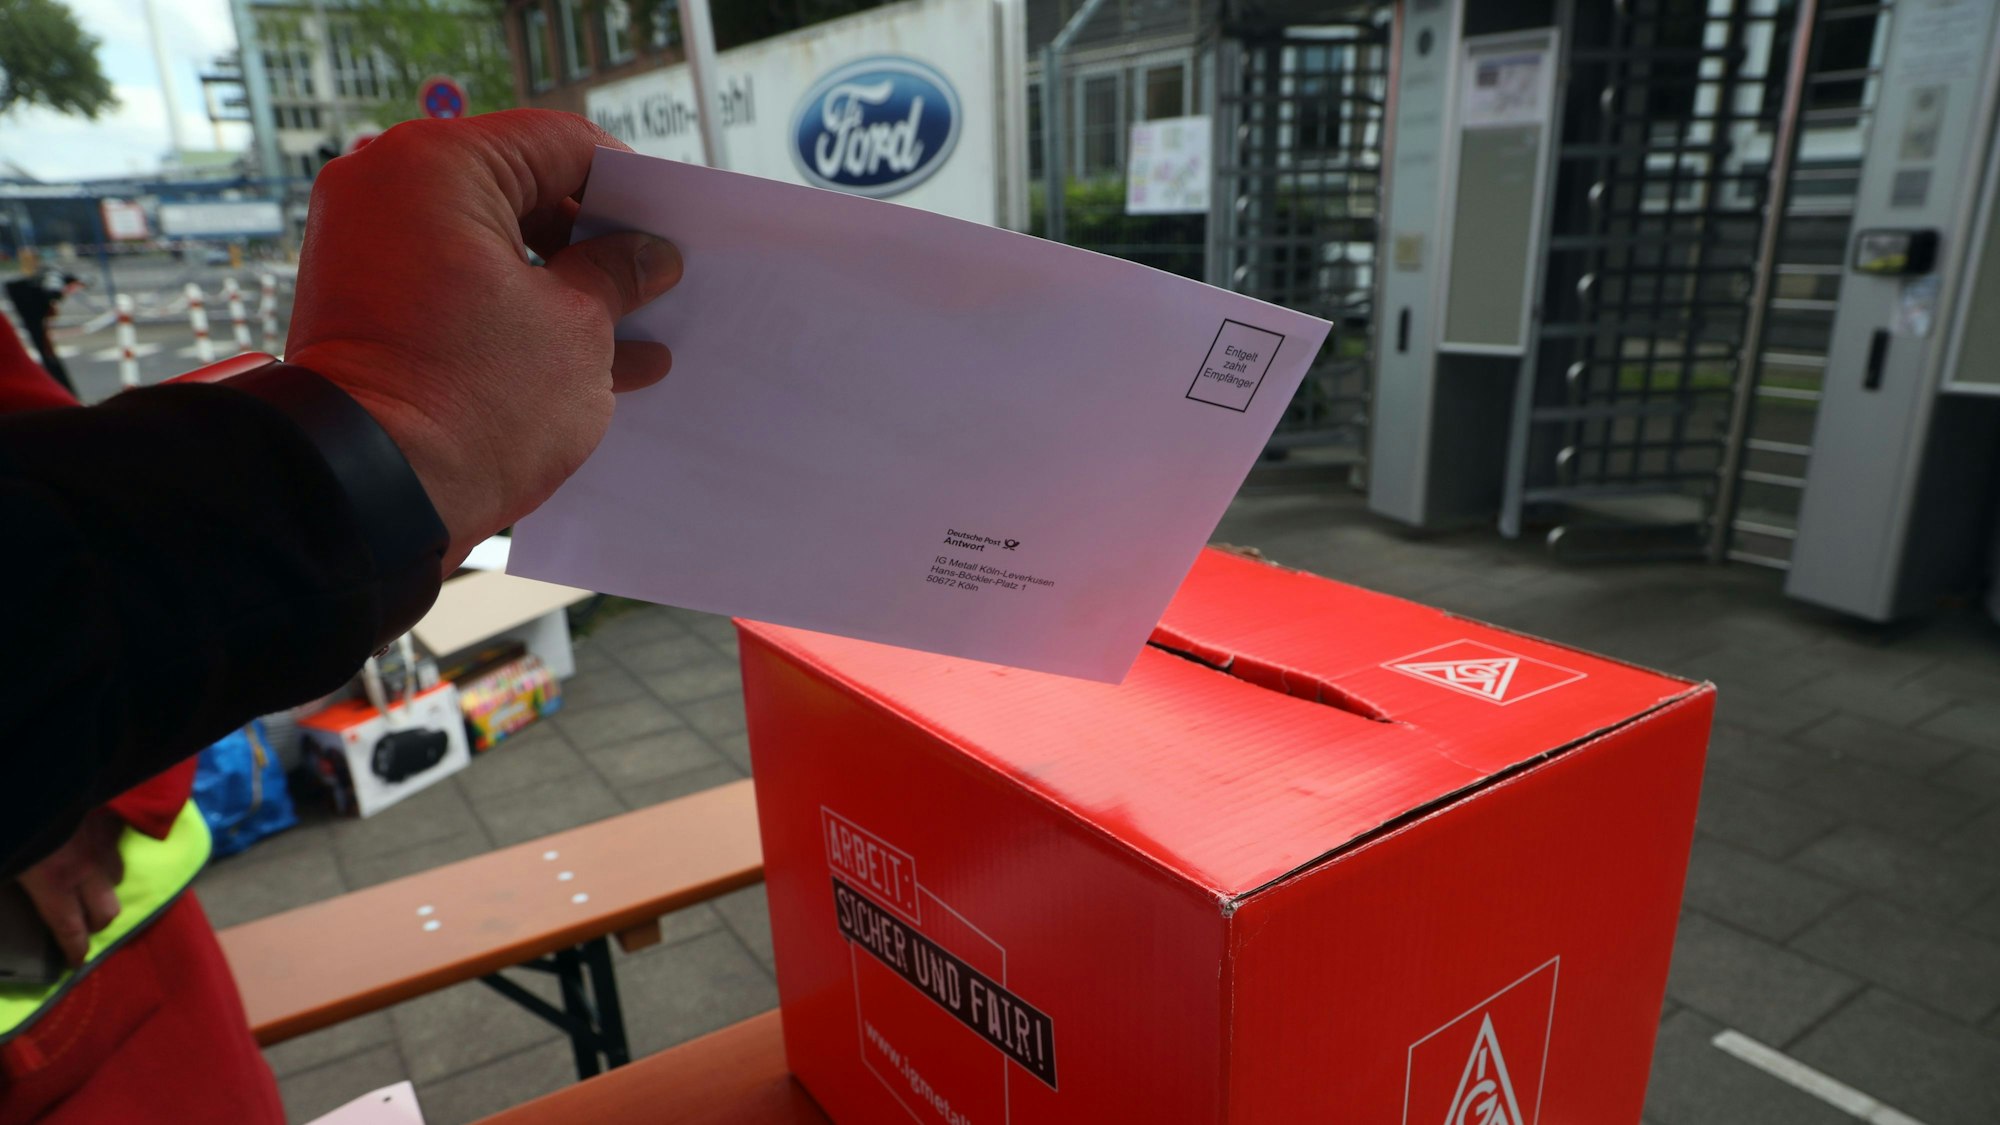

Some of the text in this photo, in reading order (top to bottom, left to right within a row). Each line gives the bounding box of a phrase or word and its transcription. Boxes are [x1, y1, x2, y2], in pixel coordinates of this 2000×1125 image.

[815, 79, 925, 180] Ford
[1225, 345, 1258, 362] Entgelt
[1223, 360, 1247, 373] zahlt
[1203, 367, 1254, 388] Empfänger
[943, 537, 985, 552] Antwort
[947, 528, 1001, 546] Deutsche Post
[930, 565, 1018, 590] Hans-Böckler-Platz
[935, 555, 1055, 588] IG Metall Köln-Leverkusen
[926, 574, 979, 592] 50672 Köln
[829, 818, 912, 910] ARBEIT:
[837, 887, 1044, 1071] SICHER UND FAIR!
